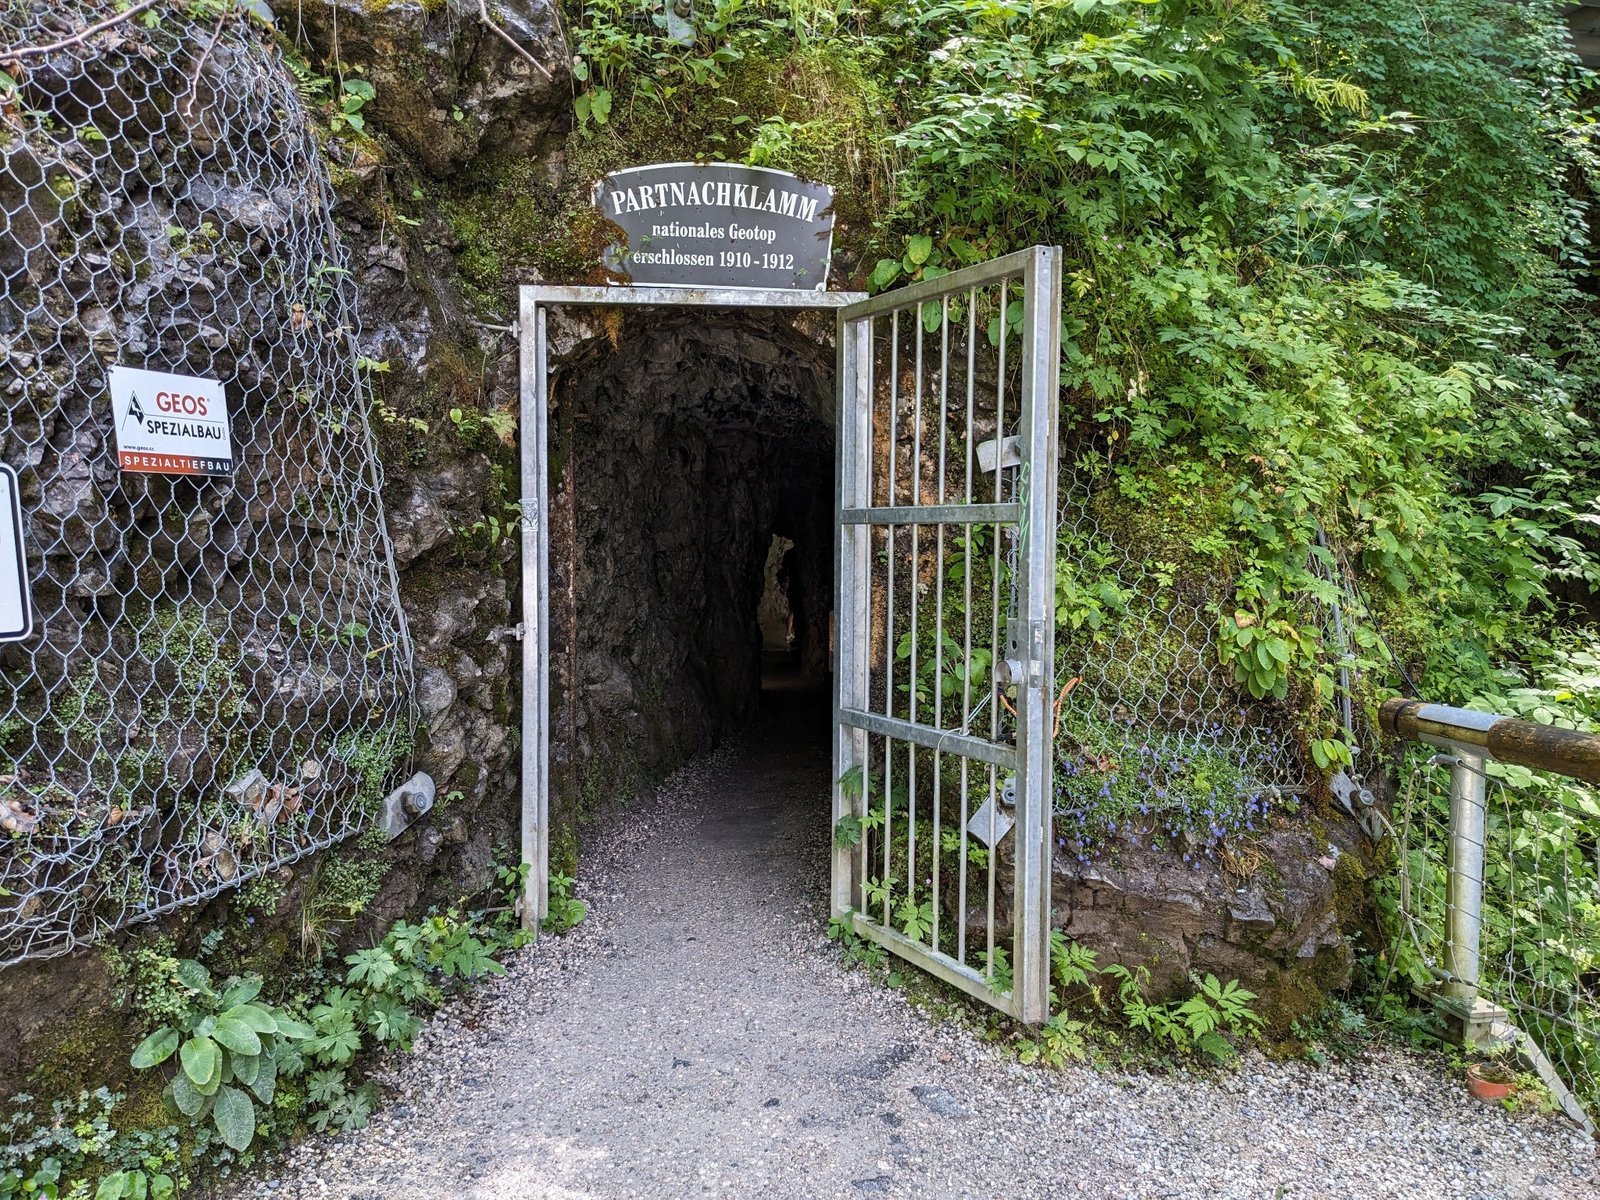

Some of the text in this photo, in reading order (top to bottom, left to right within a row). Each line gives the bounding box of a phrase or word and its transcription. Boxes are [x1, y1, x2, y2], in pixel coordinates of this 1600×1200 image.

[611, 181, 819, 223] PARTNACHKLAMM
[652, 221, 776, 244] nationales Geotop
[633, 249, 714, 267] erschlossen
[147, 420, 221, 440] SPEZIALBAU
[125, 455, 230, 472] SPEZIALTIEFBAU
